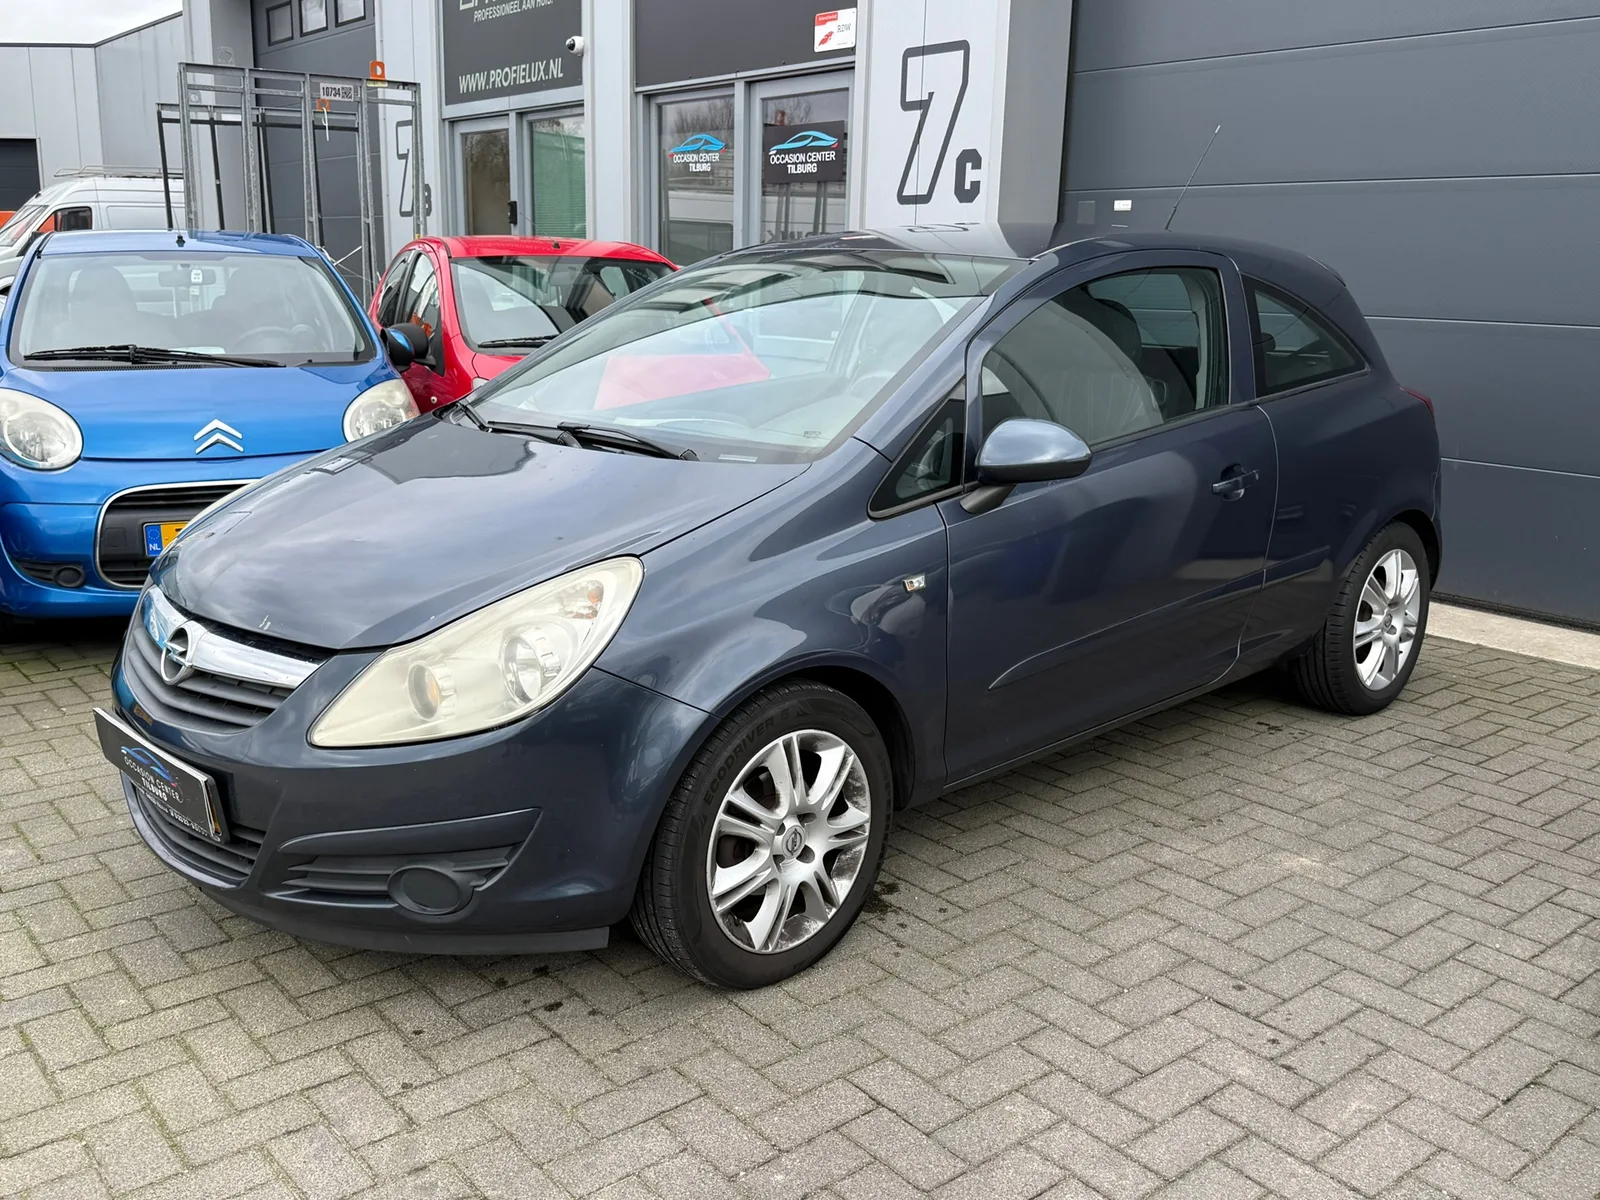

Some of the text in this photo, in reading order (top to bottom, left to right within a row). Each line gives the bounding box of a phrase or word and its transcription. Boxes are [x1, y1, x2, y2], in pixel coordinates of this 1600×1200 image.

[473, 4, 521, 22] PROFESSIONEEL
[521, 0, 536, 11] AAN
[459, 57, 563, 94] WWW.PROFIELUX.NL
[322, 86, 341, 98] 10734
[673, 152, 720, 163] OCCASION CENTER
[769, 151, 836, 164] OCCASION CENTER
[689, 163, 711, 172] TILBURG
[786, 163, 817, 174] TILBURG
[149, 543, 161, 551] NL
[703, 716, 775, 805] ECODRIVER
[124, 756, 180, 801] OCCASION CENTER
